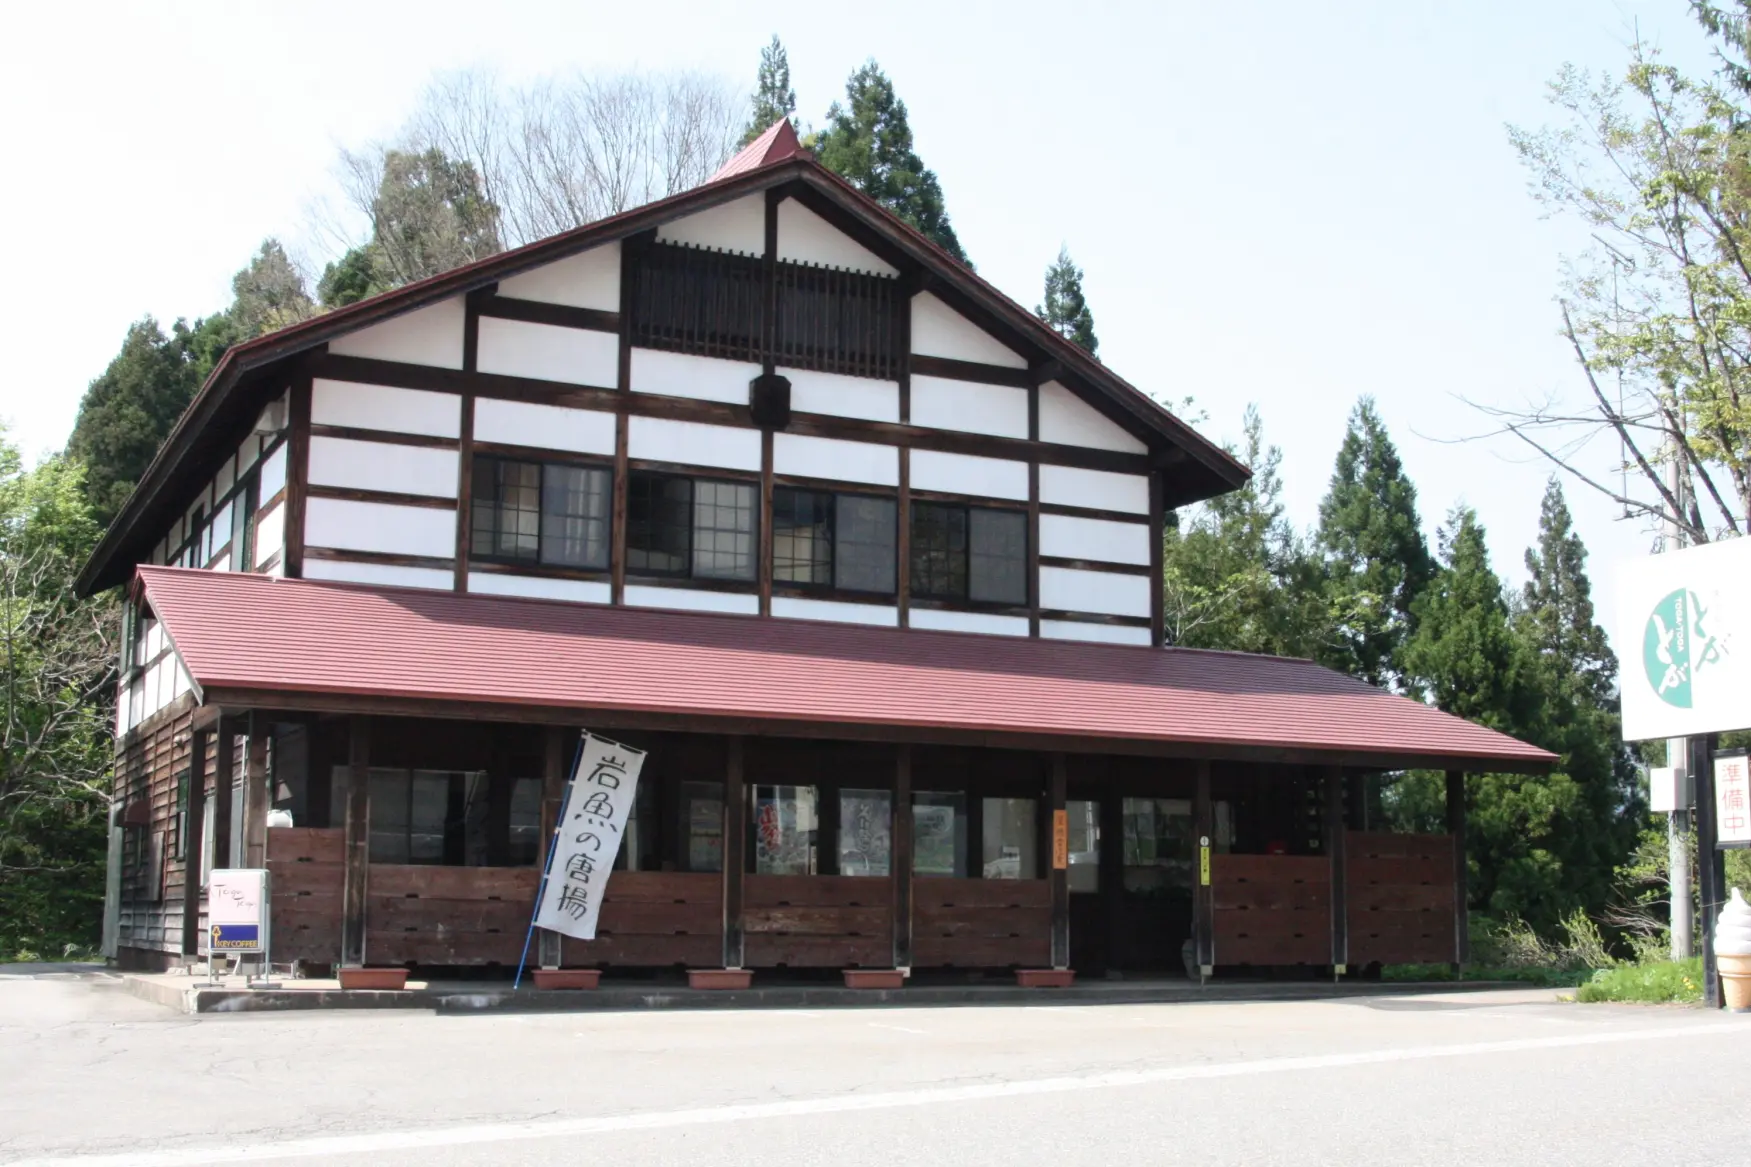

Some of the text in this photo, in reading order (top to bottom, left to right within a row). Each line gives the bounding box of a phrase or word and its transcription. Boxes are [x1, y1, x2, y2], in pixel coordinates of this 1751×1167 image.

[557, 755, 627, 921] 岩魚の唐揚
[1721, 763, 1745, 836] 準備中
